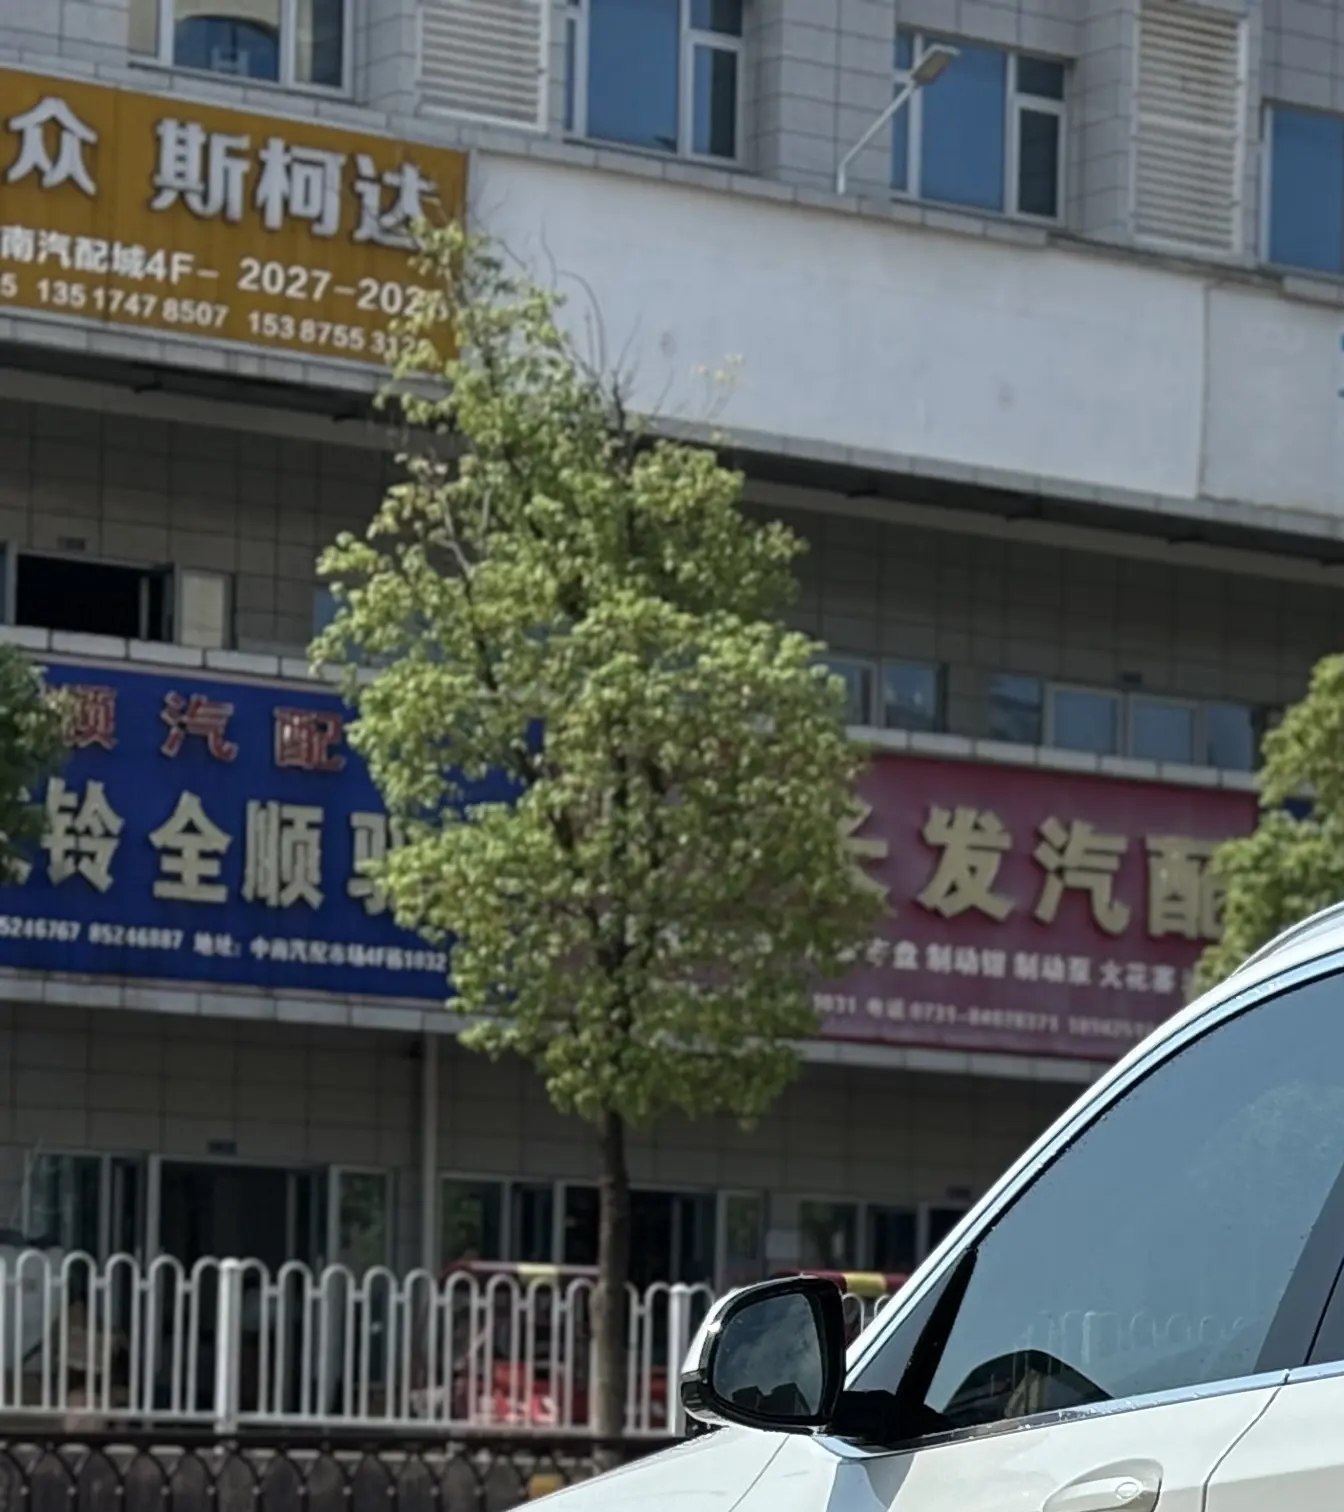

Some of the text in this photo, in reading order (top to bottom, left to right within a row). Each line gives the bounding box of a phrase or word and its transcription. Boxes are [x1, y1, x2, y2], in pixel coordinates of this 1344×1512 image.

[7, 96, 440, 250] 众 斯柯达
